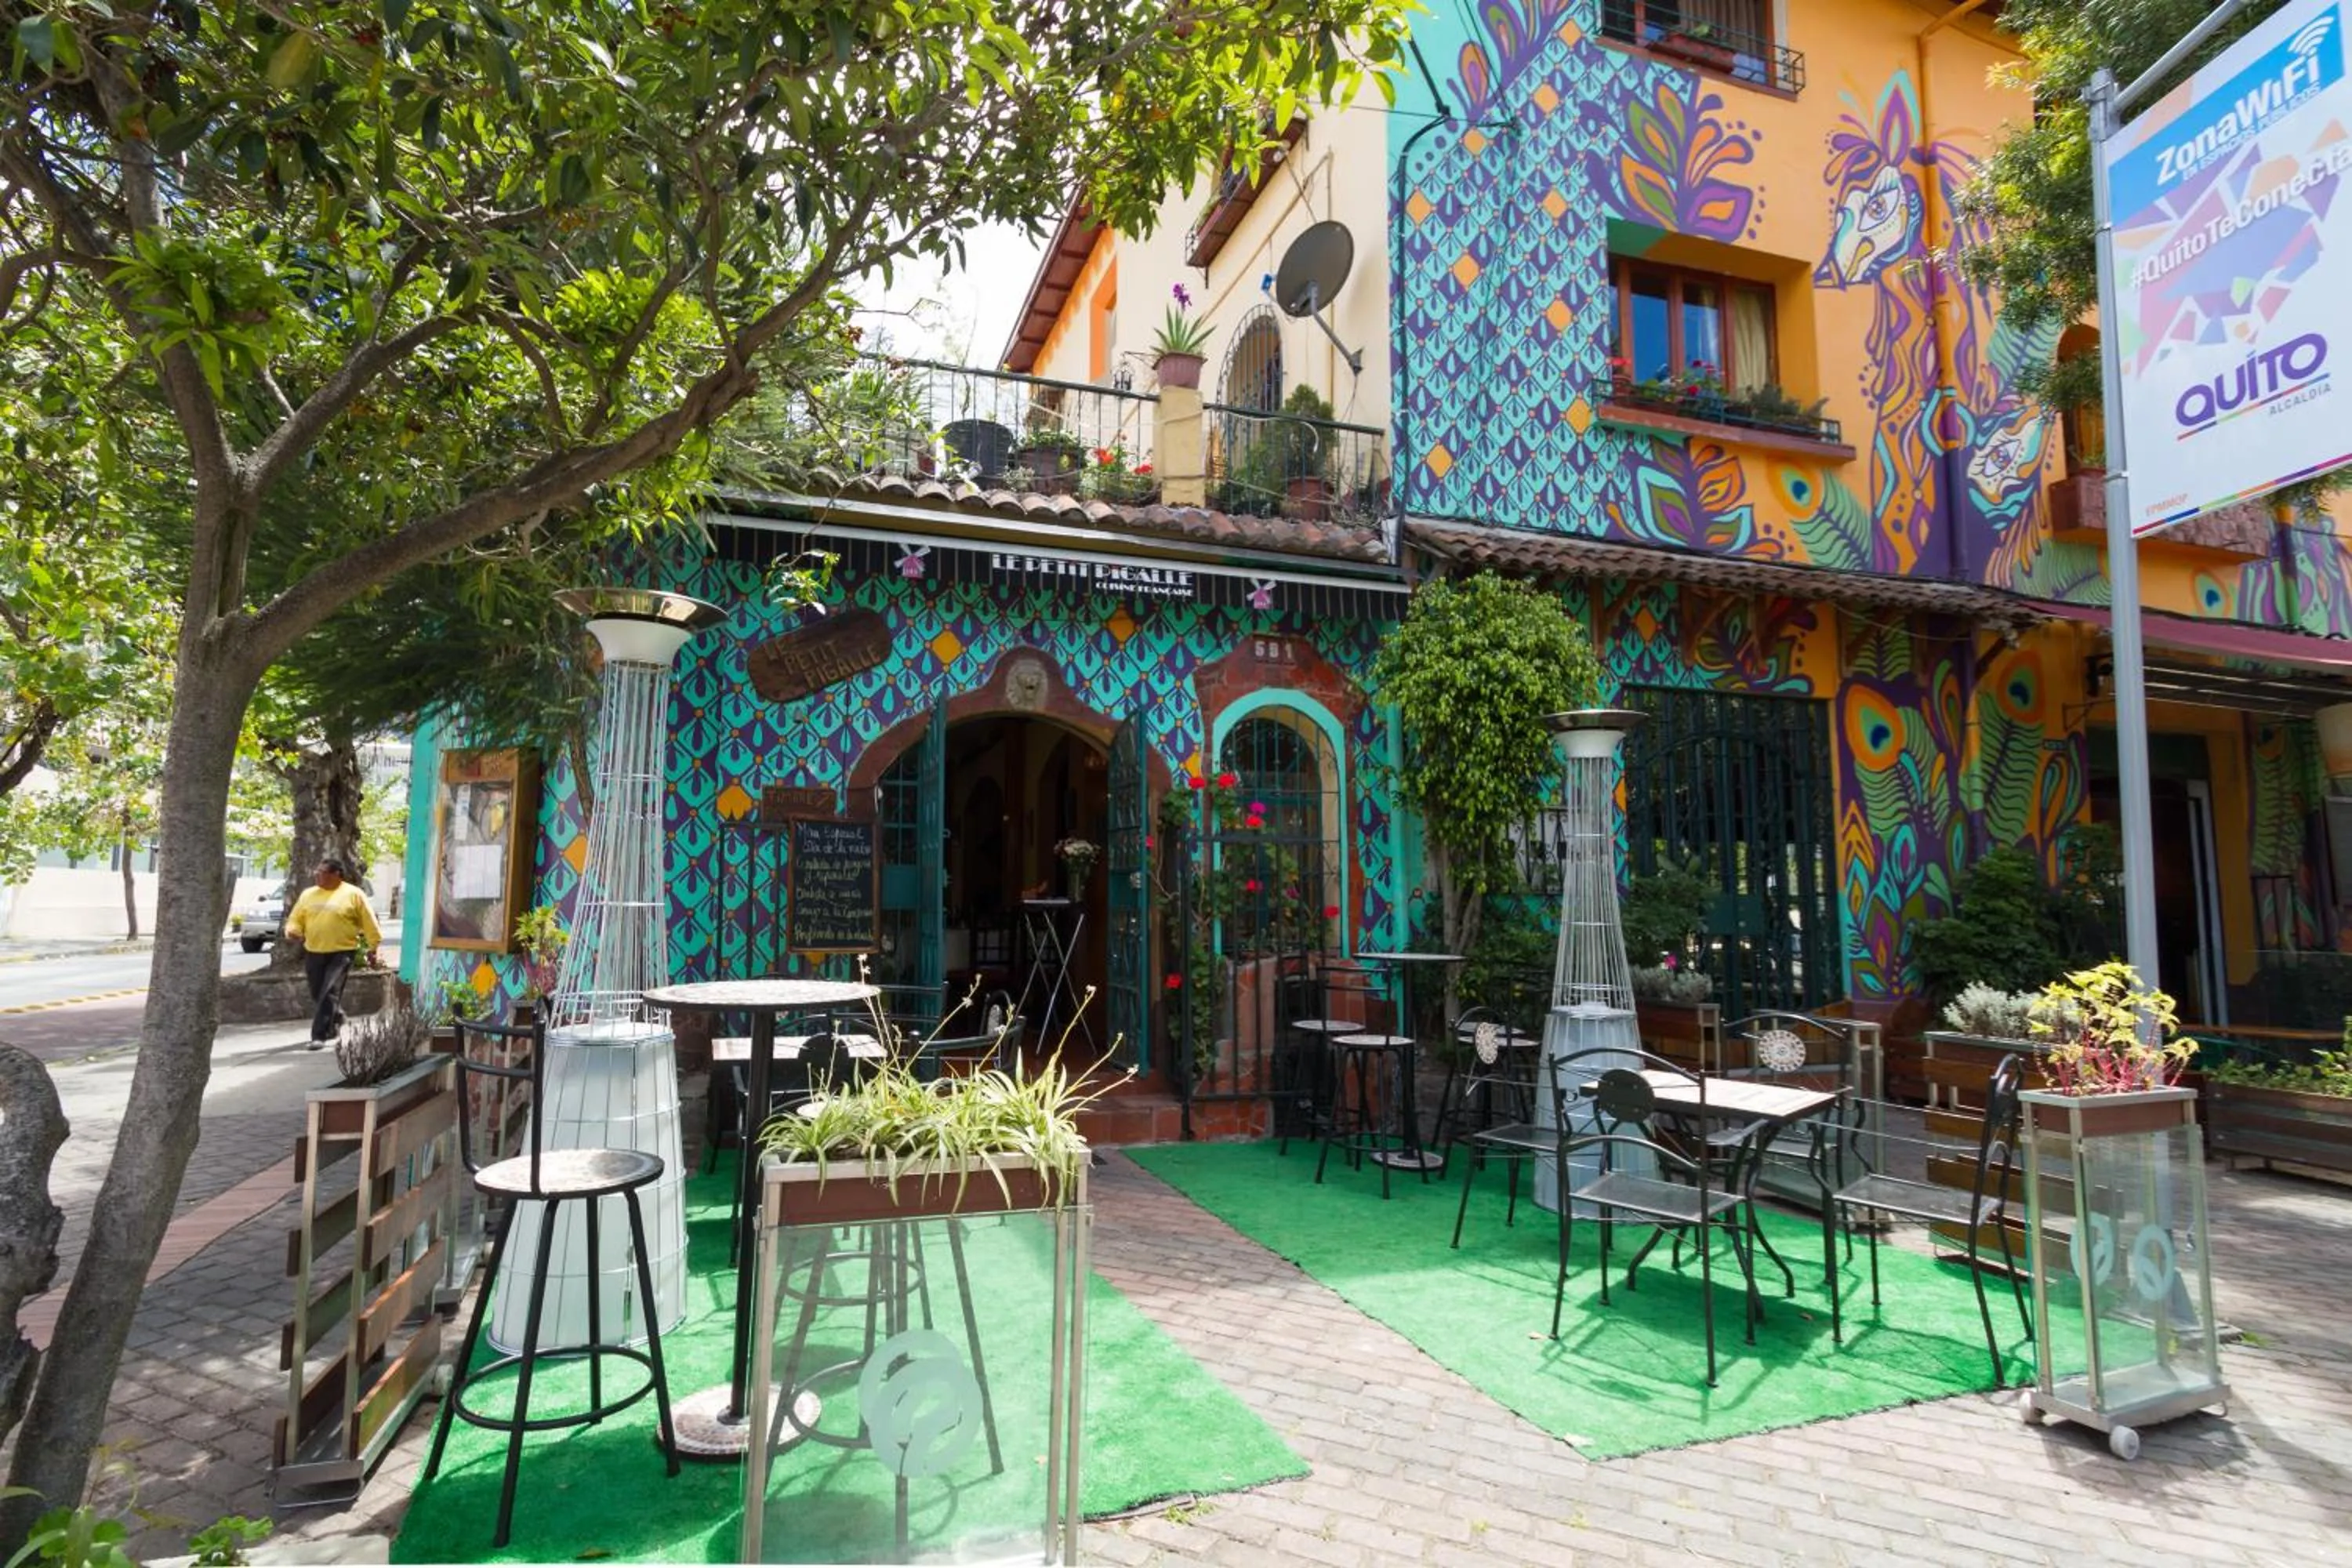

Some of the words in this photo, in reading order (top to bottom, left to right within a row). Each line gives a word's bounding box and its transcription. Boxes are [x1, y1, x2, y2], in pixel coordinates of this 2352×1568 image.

[2155, 47, 2320, 185] ZonaWiFi
[2130, 144, 2352, 289] #QuitoTeConecta
[992, 554, 1021, 571] LE
[1025, 557, 1091, 577] PETIT
[1094, 564, 1193, 586] PIGALLE
[784, 640, 840, 675] PETIT
[804, 644, 880, 689] PIGALLE
